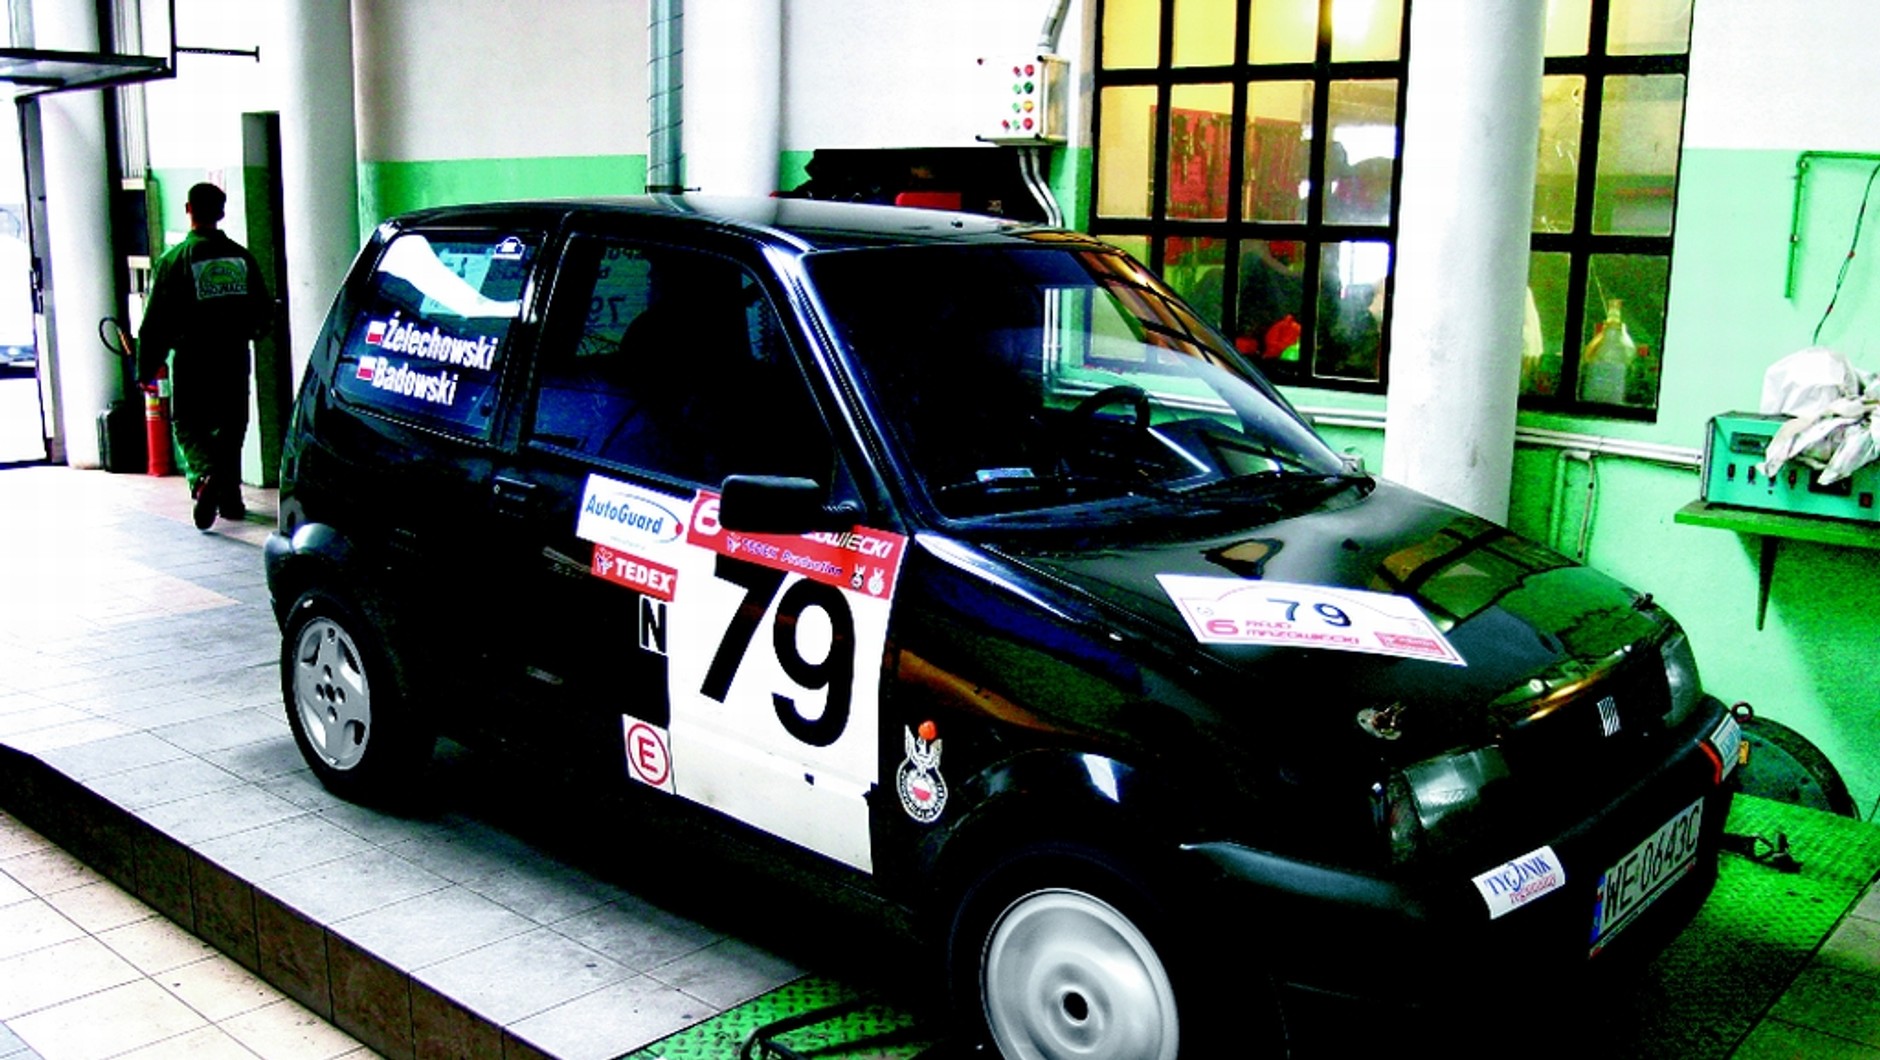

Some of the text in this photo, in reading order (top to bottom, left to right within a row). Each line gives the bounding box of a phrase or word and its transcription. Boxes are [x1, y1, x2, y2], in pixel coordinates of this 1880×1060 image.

[382, 311, 499, 371] Żelechowski
[372, 355, 459, 406] Badowski
[585, 494, 665, 535] AutoGuard
[615, 556, 676, 594] TEDEX
[640, 595, 668, 654] N
[1206, 619, 1239, 635] 6
[1266, 597, 1352, 628] 79
[699, 553, 856, 748] 79
[637, 735, 660, 774] E
[1603, 852, 1640, 925] WE
